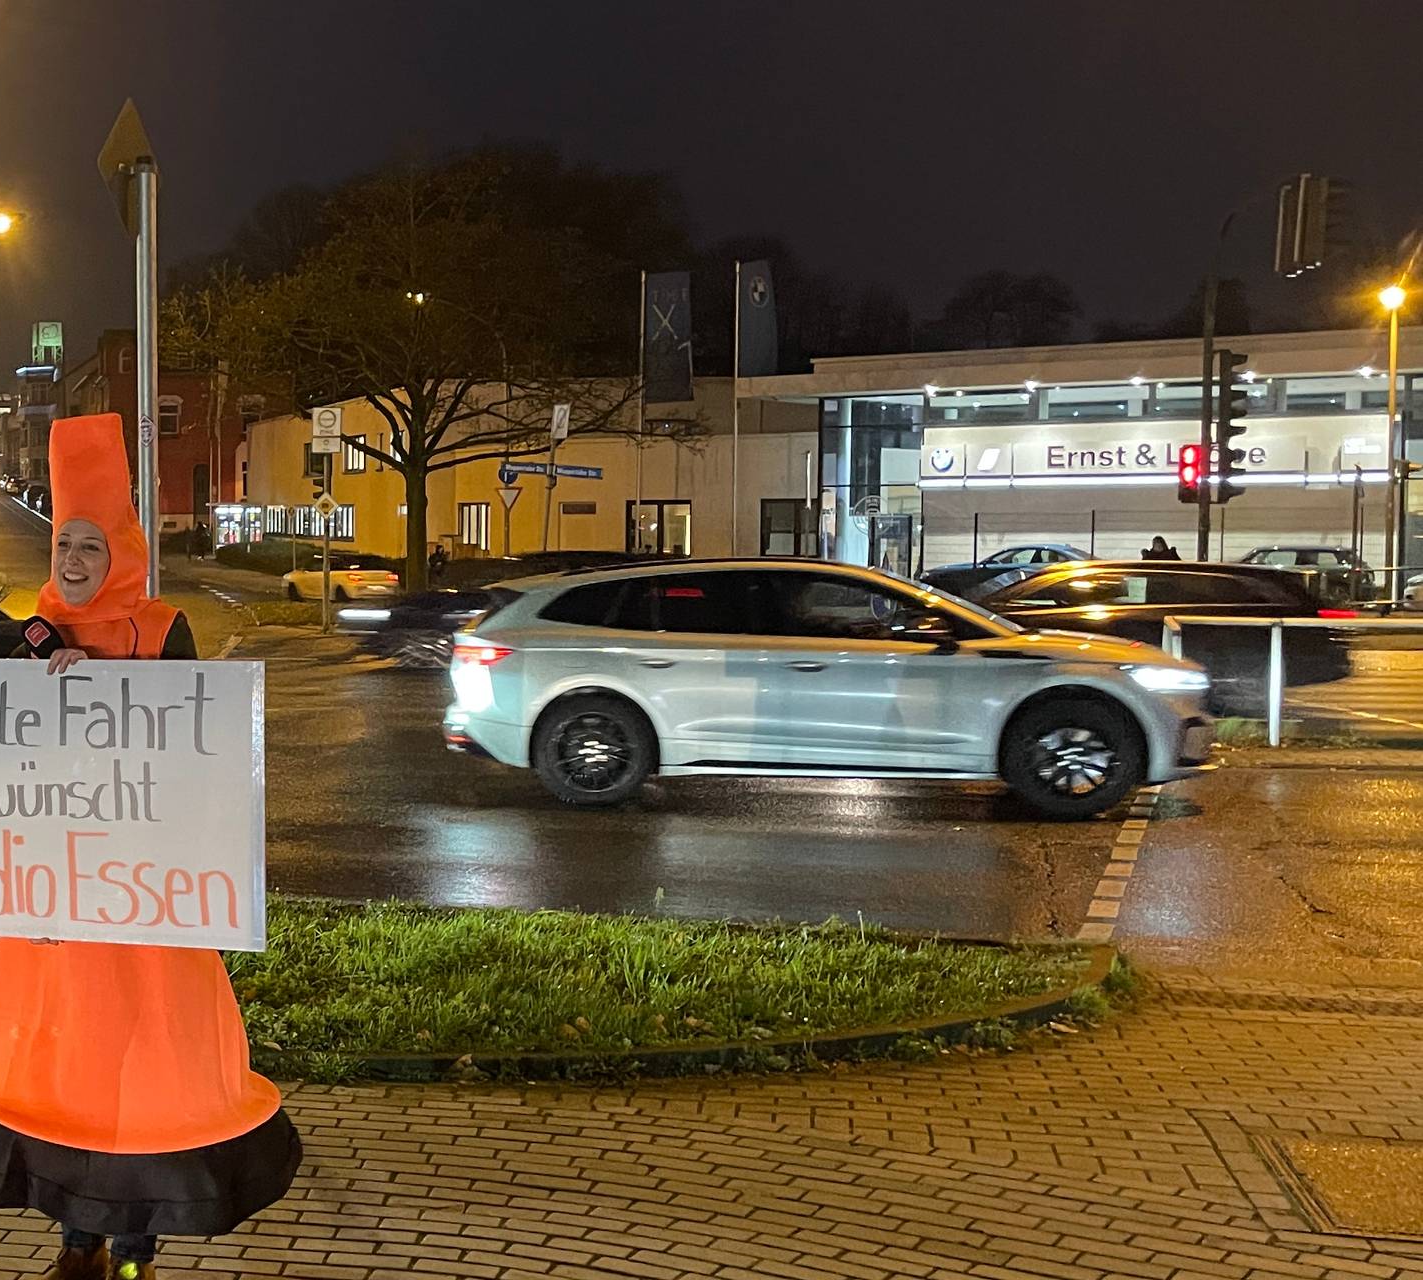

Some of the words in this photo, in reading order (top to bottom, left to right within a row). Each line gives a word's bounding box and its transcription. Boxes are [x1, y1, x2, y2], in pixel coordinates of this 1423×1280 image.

[1047, 444, 1127, 469] Ernst
[1135, 442, 1157, 467] &
[59, 672, 218, 756] Fahrt
[66, 831, 240, 929] Essen
